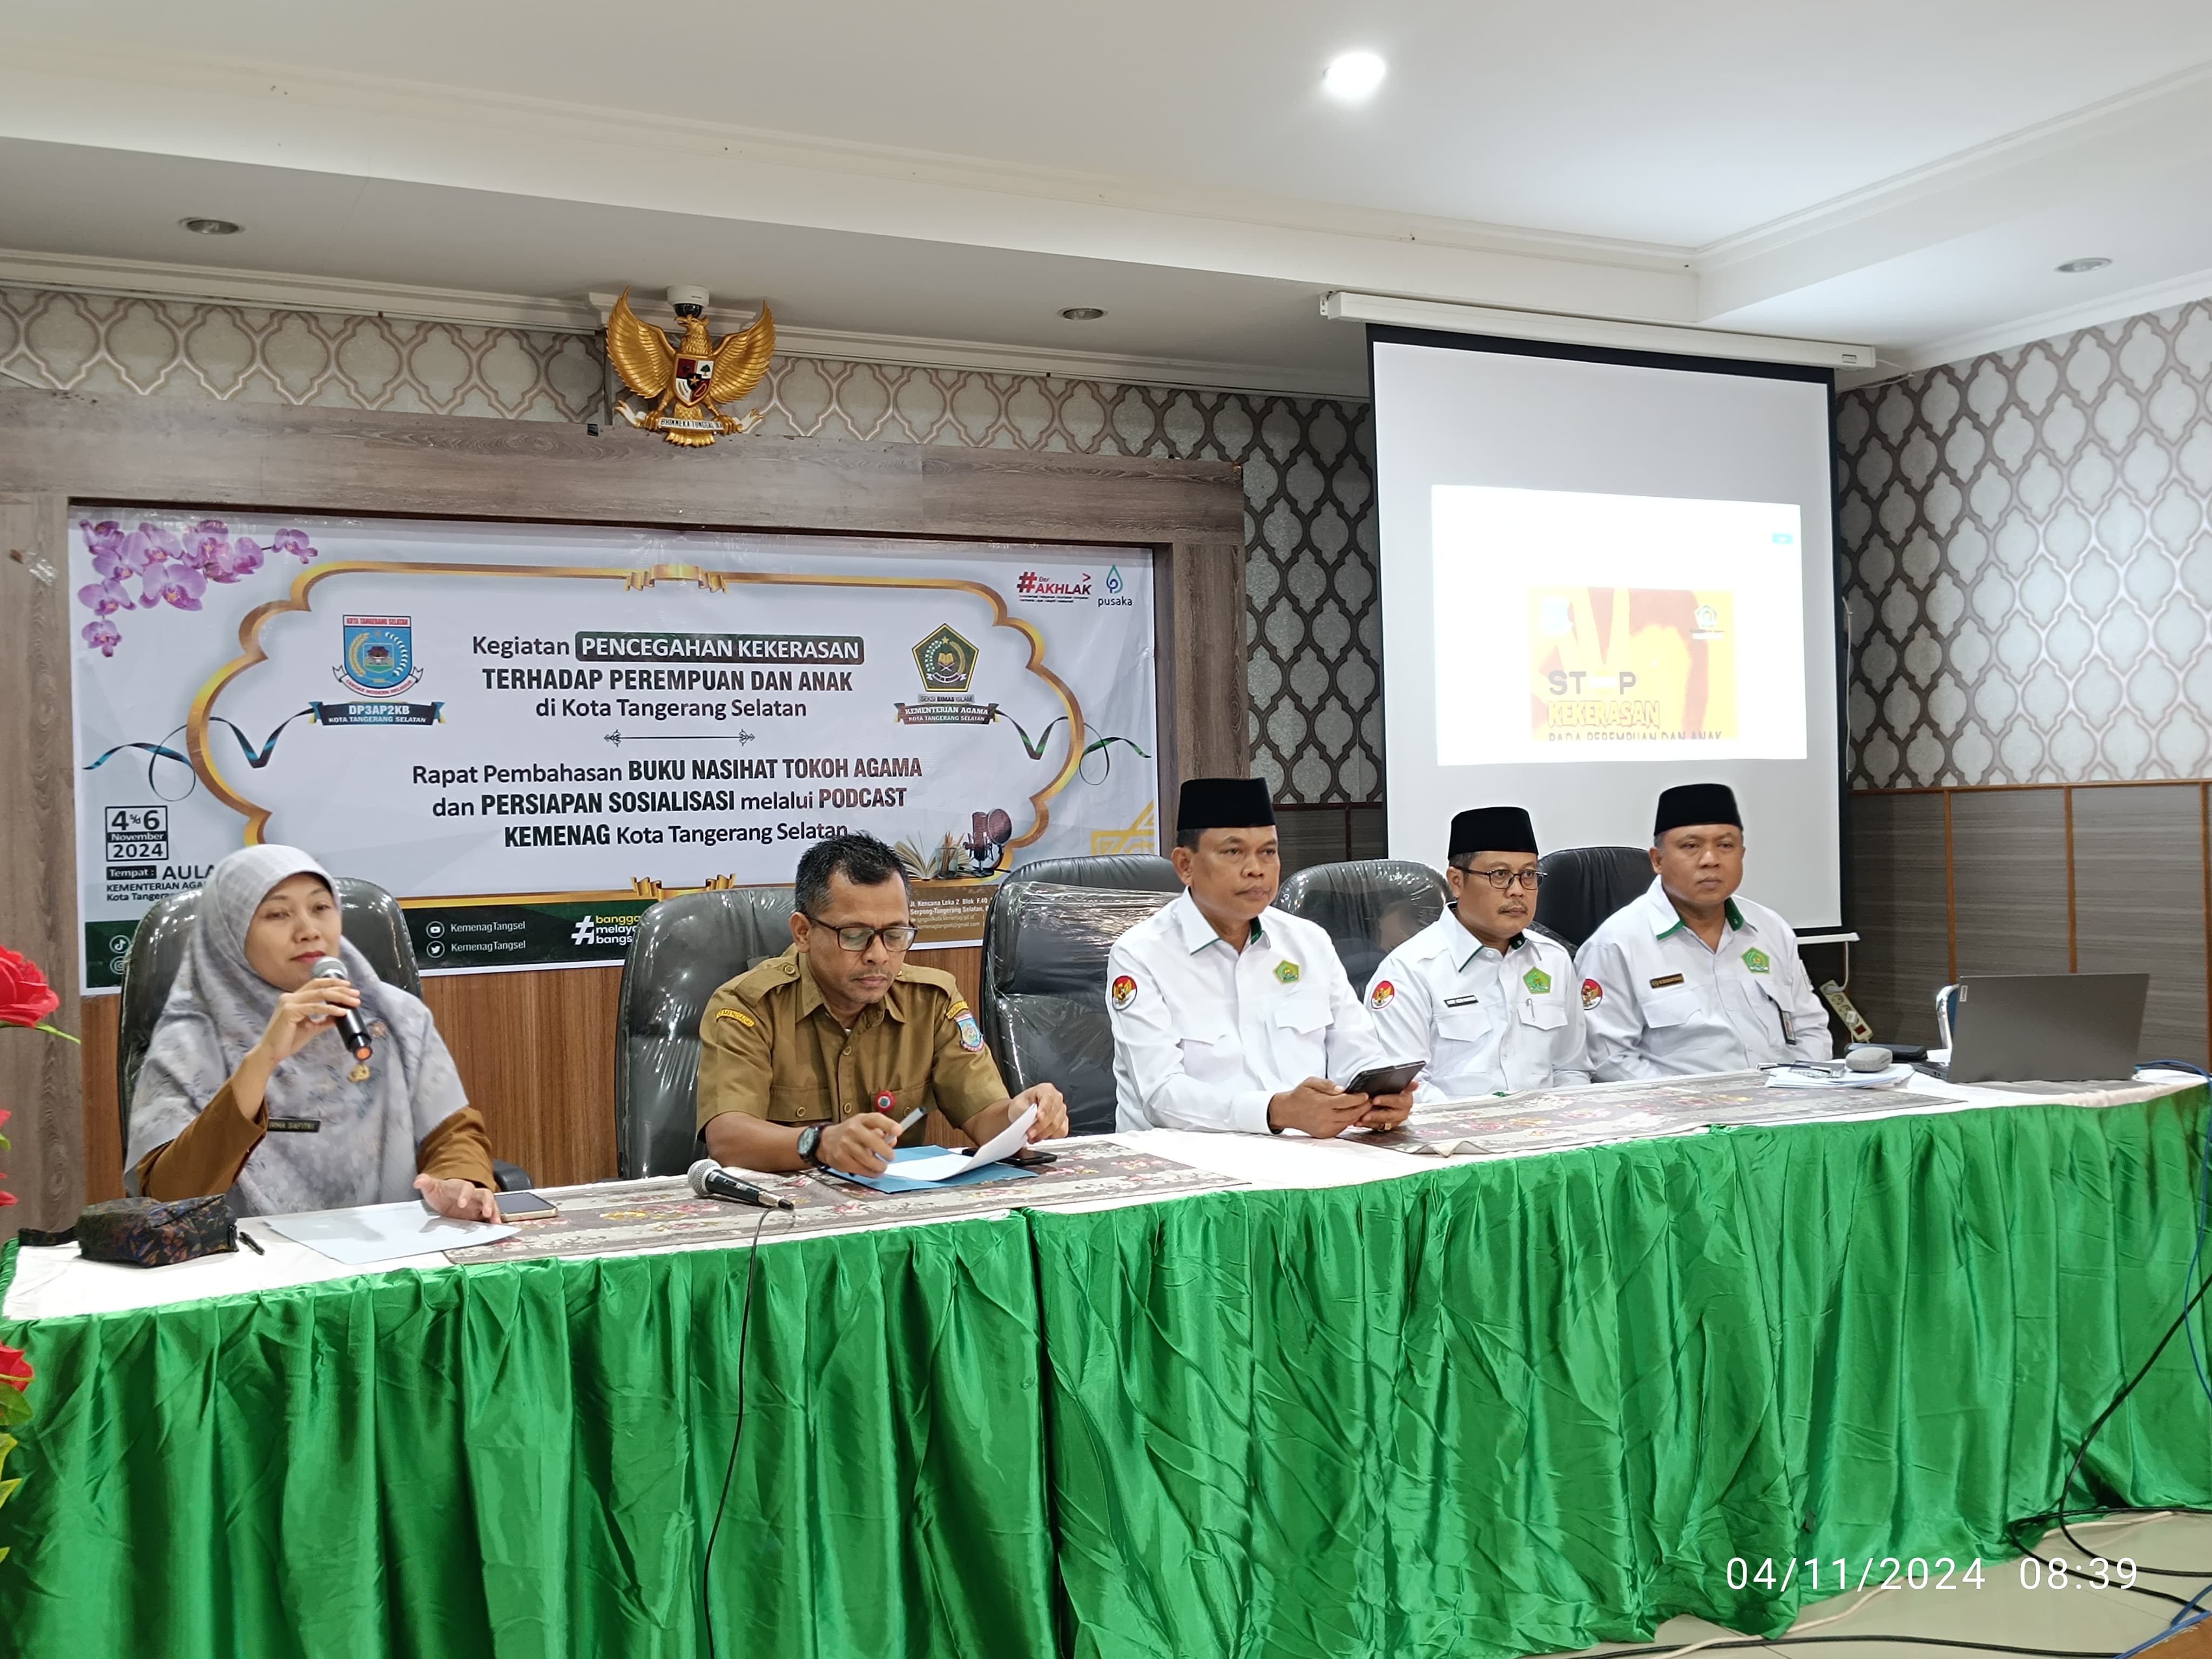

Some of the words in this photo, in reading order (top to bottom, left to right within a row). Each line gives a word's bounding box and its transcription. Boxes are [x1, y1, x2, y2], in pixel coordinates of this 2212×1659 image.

[660, 419, 690, 427] BHINNEKA
[1098, 597, 1132, 607] pusaka
[473, 636, 569, 658] Kegiatan
[582, 638, 732, 657] PENCEGAHAN
[738, 639, 859, 658] KEKERASAN
[482, 669, 603, 690] TERHADAP
[610, 669, 744, 691] PEREMPUAN
[751, 671, 792, 691] DAN
[799, 672, 852, 691] ANAK
[349, 705, 410, 714] DP3AP2KB
[536, 699, 558, 717] di
[563, 699, 611, 717] Kota
[617, 700, 726, 720] Tangerang
[732, 699, 806, 717] Selatan
[1548, 700, 1660, 729] KEKERASAN
[413, 766, 477, 787] Rapat
[484, 763, 622, 783] Pembahasan
[629, 760, 685, 780] BUKU
[692, 759, 778, 780] NASIHAT
[782, 759, 848, 779] TOKOH
[854, 758, 921, 778] AGAMA
[432, 797, 474, 818] dan
[482, 793, 602, 815] PERSIAPAN
[609, 791, 734, 813] SOSIALISASI
[741, 791, 813, 811] melalui
[819, 787, 907, 808] PODCAST
[111, 811, 129, 831] 4
[143, 810, 160, 830] 6
[111, 833, 164, 841] November
[505, 825, 609, 847] KEMENAG
[617, 827, 663, 845] Kota
[668, 825, 771, 846] Tangerang
[777, 821, 847, 840] Selatan
[113, 844, 163, 858] 2024
[106, 882, 179, 892] KEMENTERIAN
[181, 881, 206, 889] AGA
[106, 893, 129, 901] Kota
[450, 921, 525, 934] KemenagTangsel
[450, 941, 526, 954] KemenagTangsel
